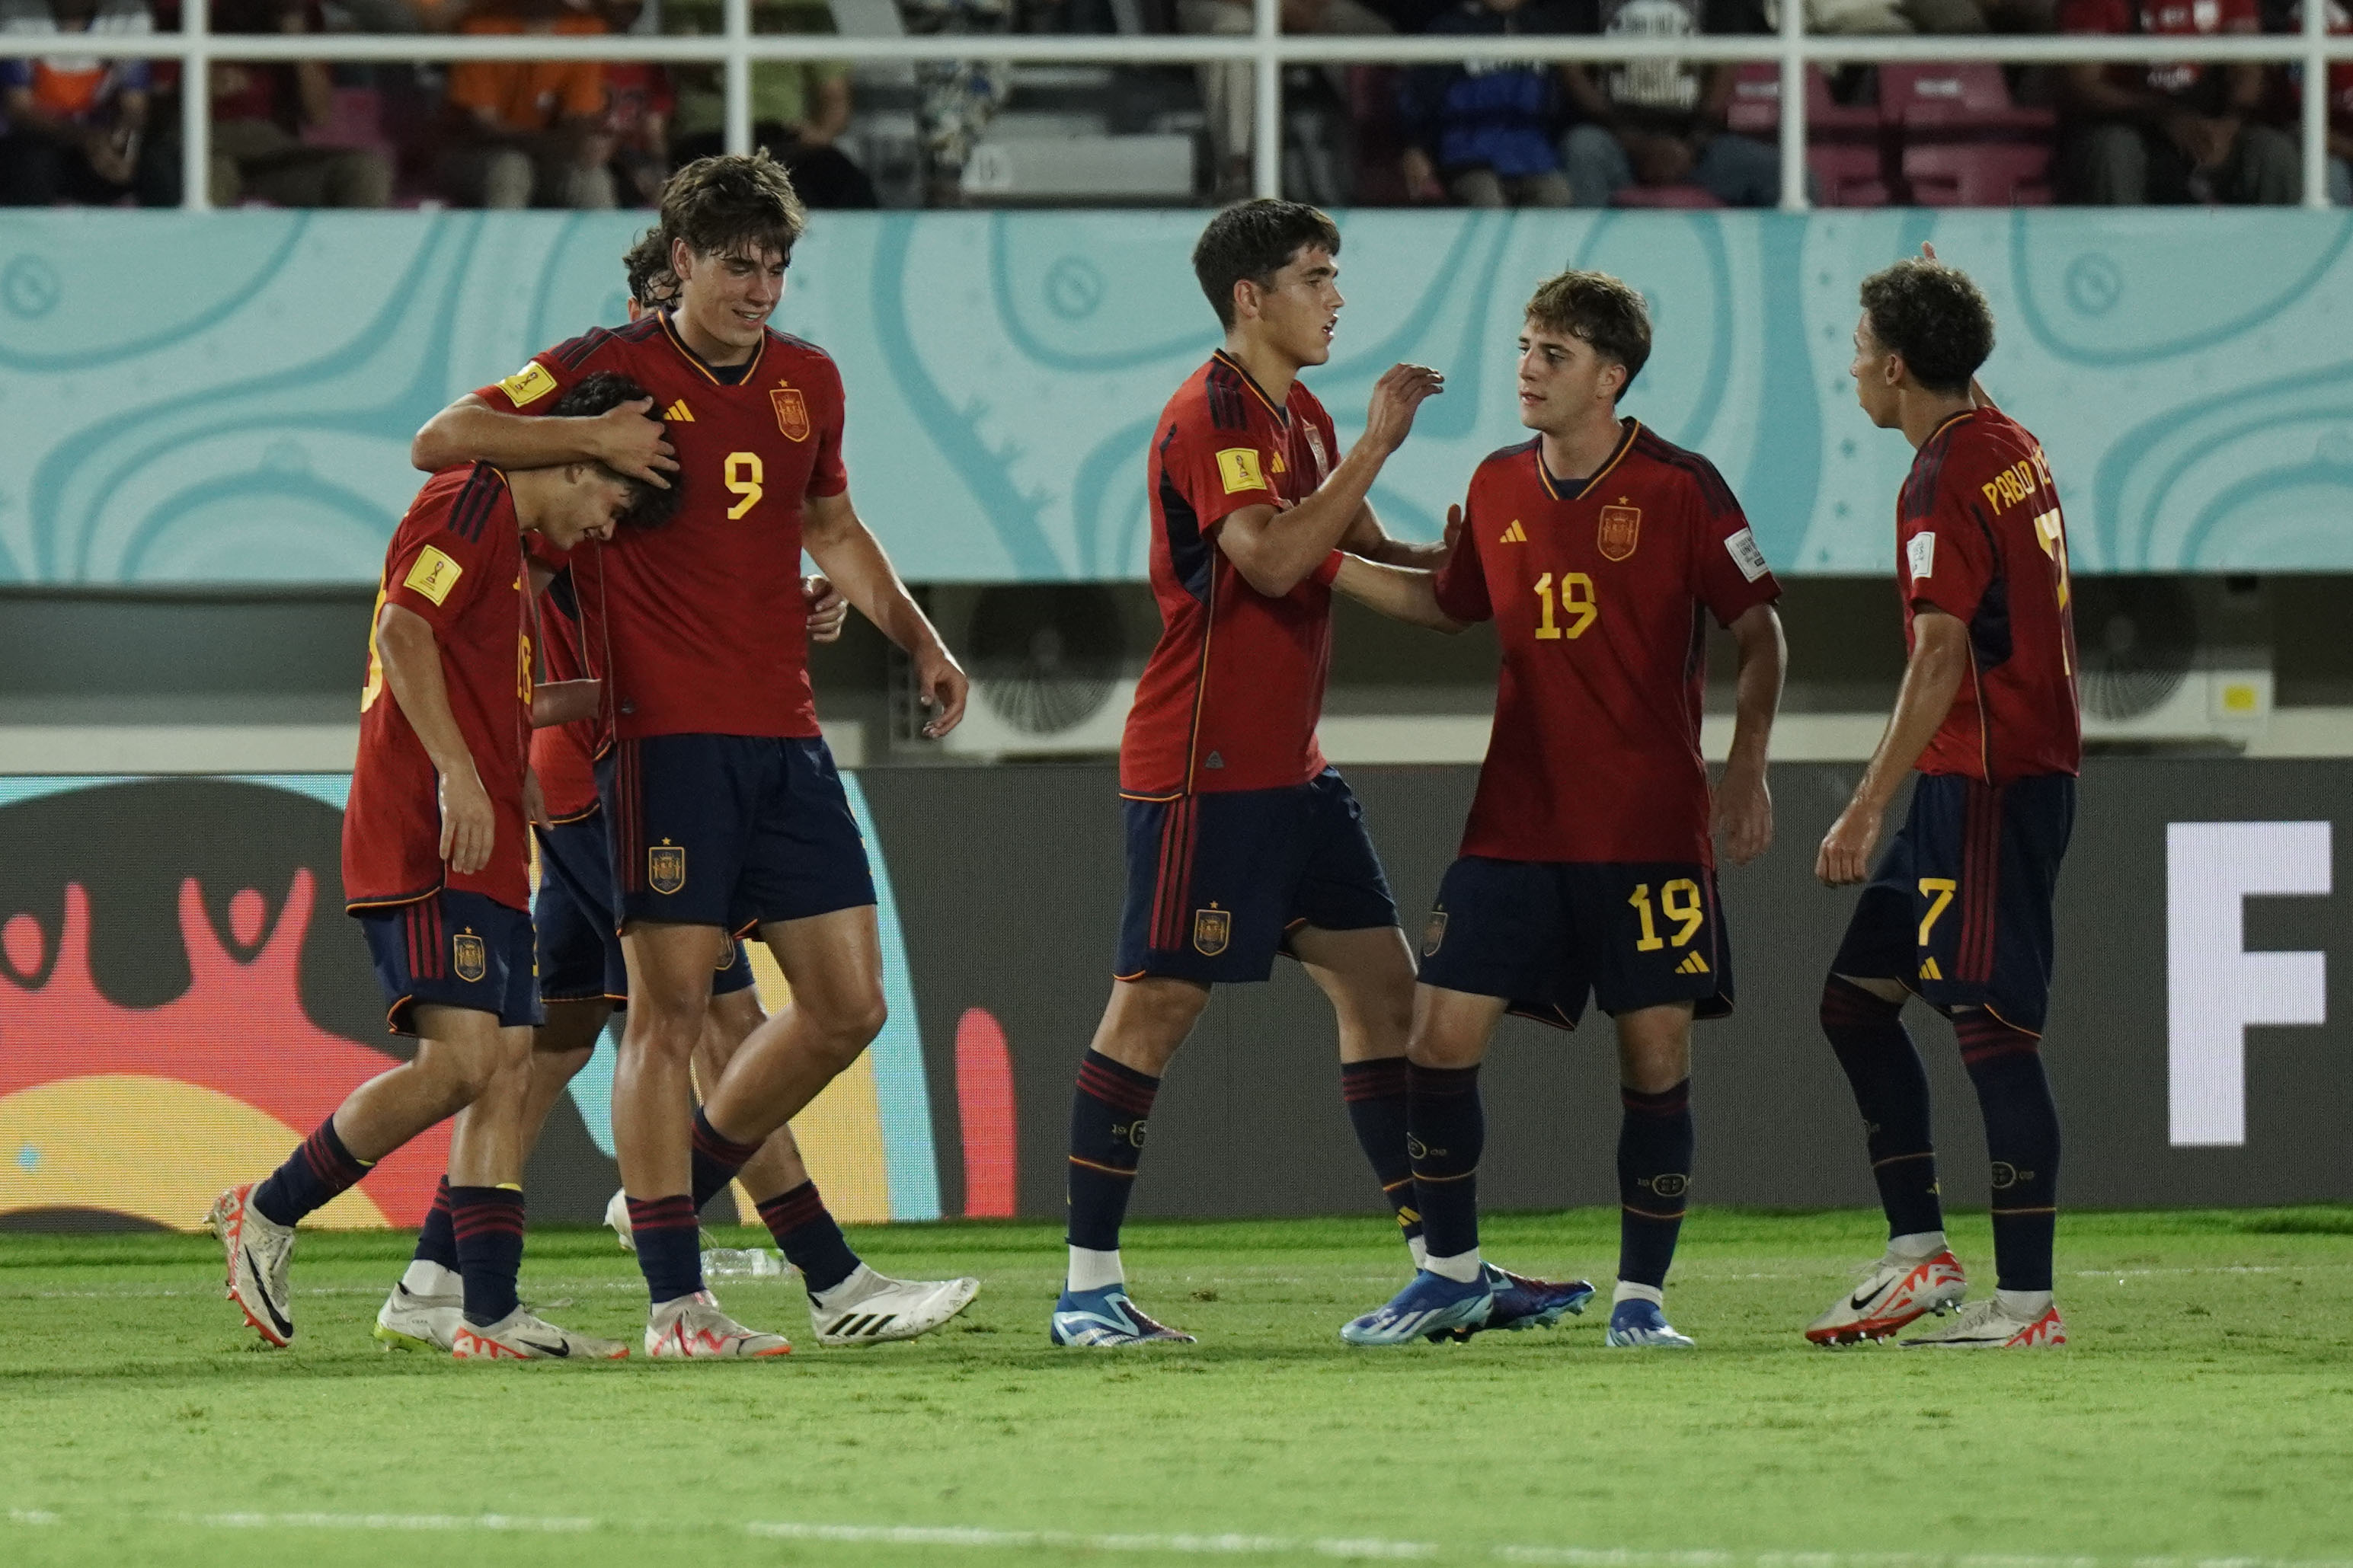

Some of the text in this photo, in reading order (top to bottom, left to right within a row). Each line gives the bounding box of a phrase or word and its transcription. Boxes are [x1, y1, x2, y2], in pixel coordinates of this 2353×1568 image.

[724, 451, 763, 520] 9
[1981, 459, 2036, 516] PABLO
[1533, 572, 1598, 640] 19
[1627, 877, 1703, 952] 19
[1918, 877, 1957, 947] 7
[2166, 820, 2332, 1146] F
